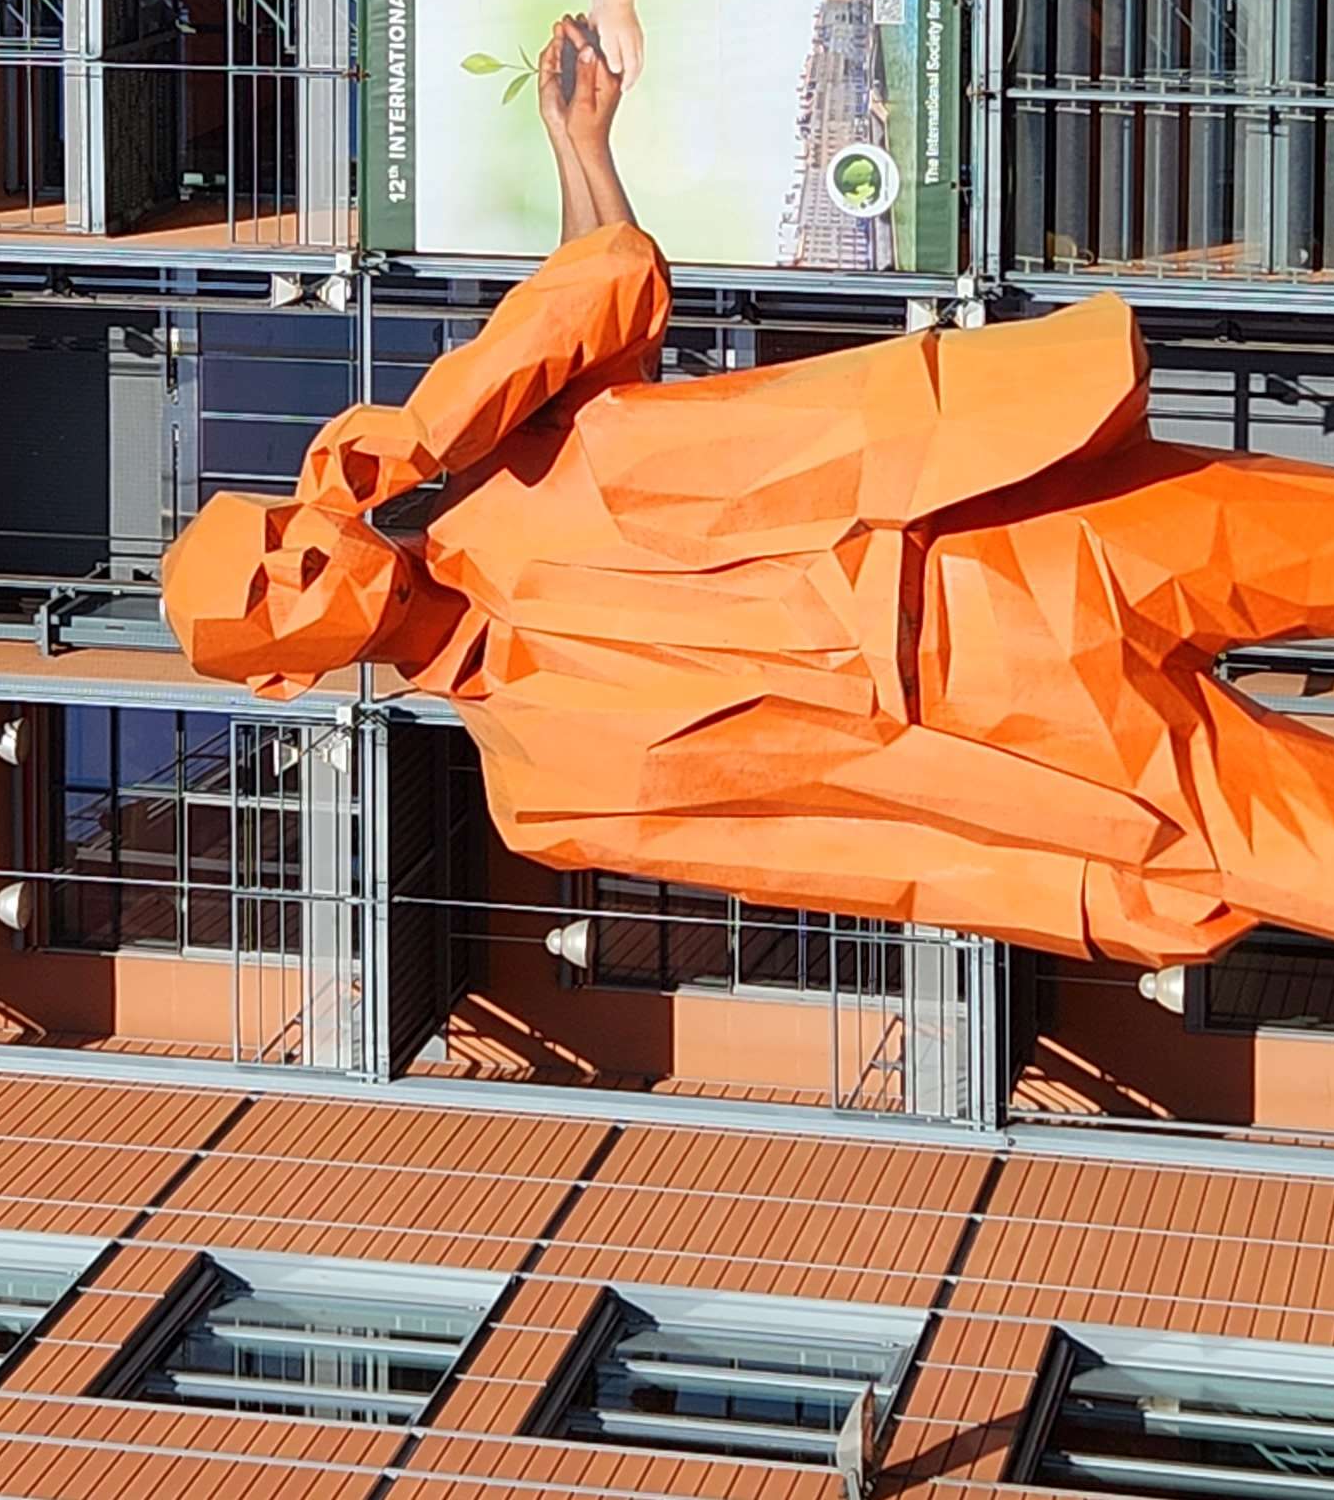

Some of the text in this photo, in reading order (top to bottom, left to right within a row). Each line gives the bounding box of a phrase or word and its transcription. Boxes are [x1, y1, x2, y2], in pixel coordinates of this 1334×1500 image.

[925, 0, 941, 20] for
[925, 22, 943, 70] Society
[924, 72, 941, 156] International
[924, 160, 940, 184] The
